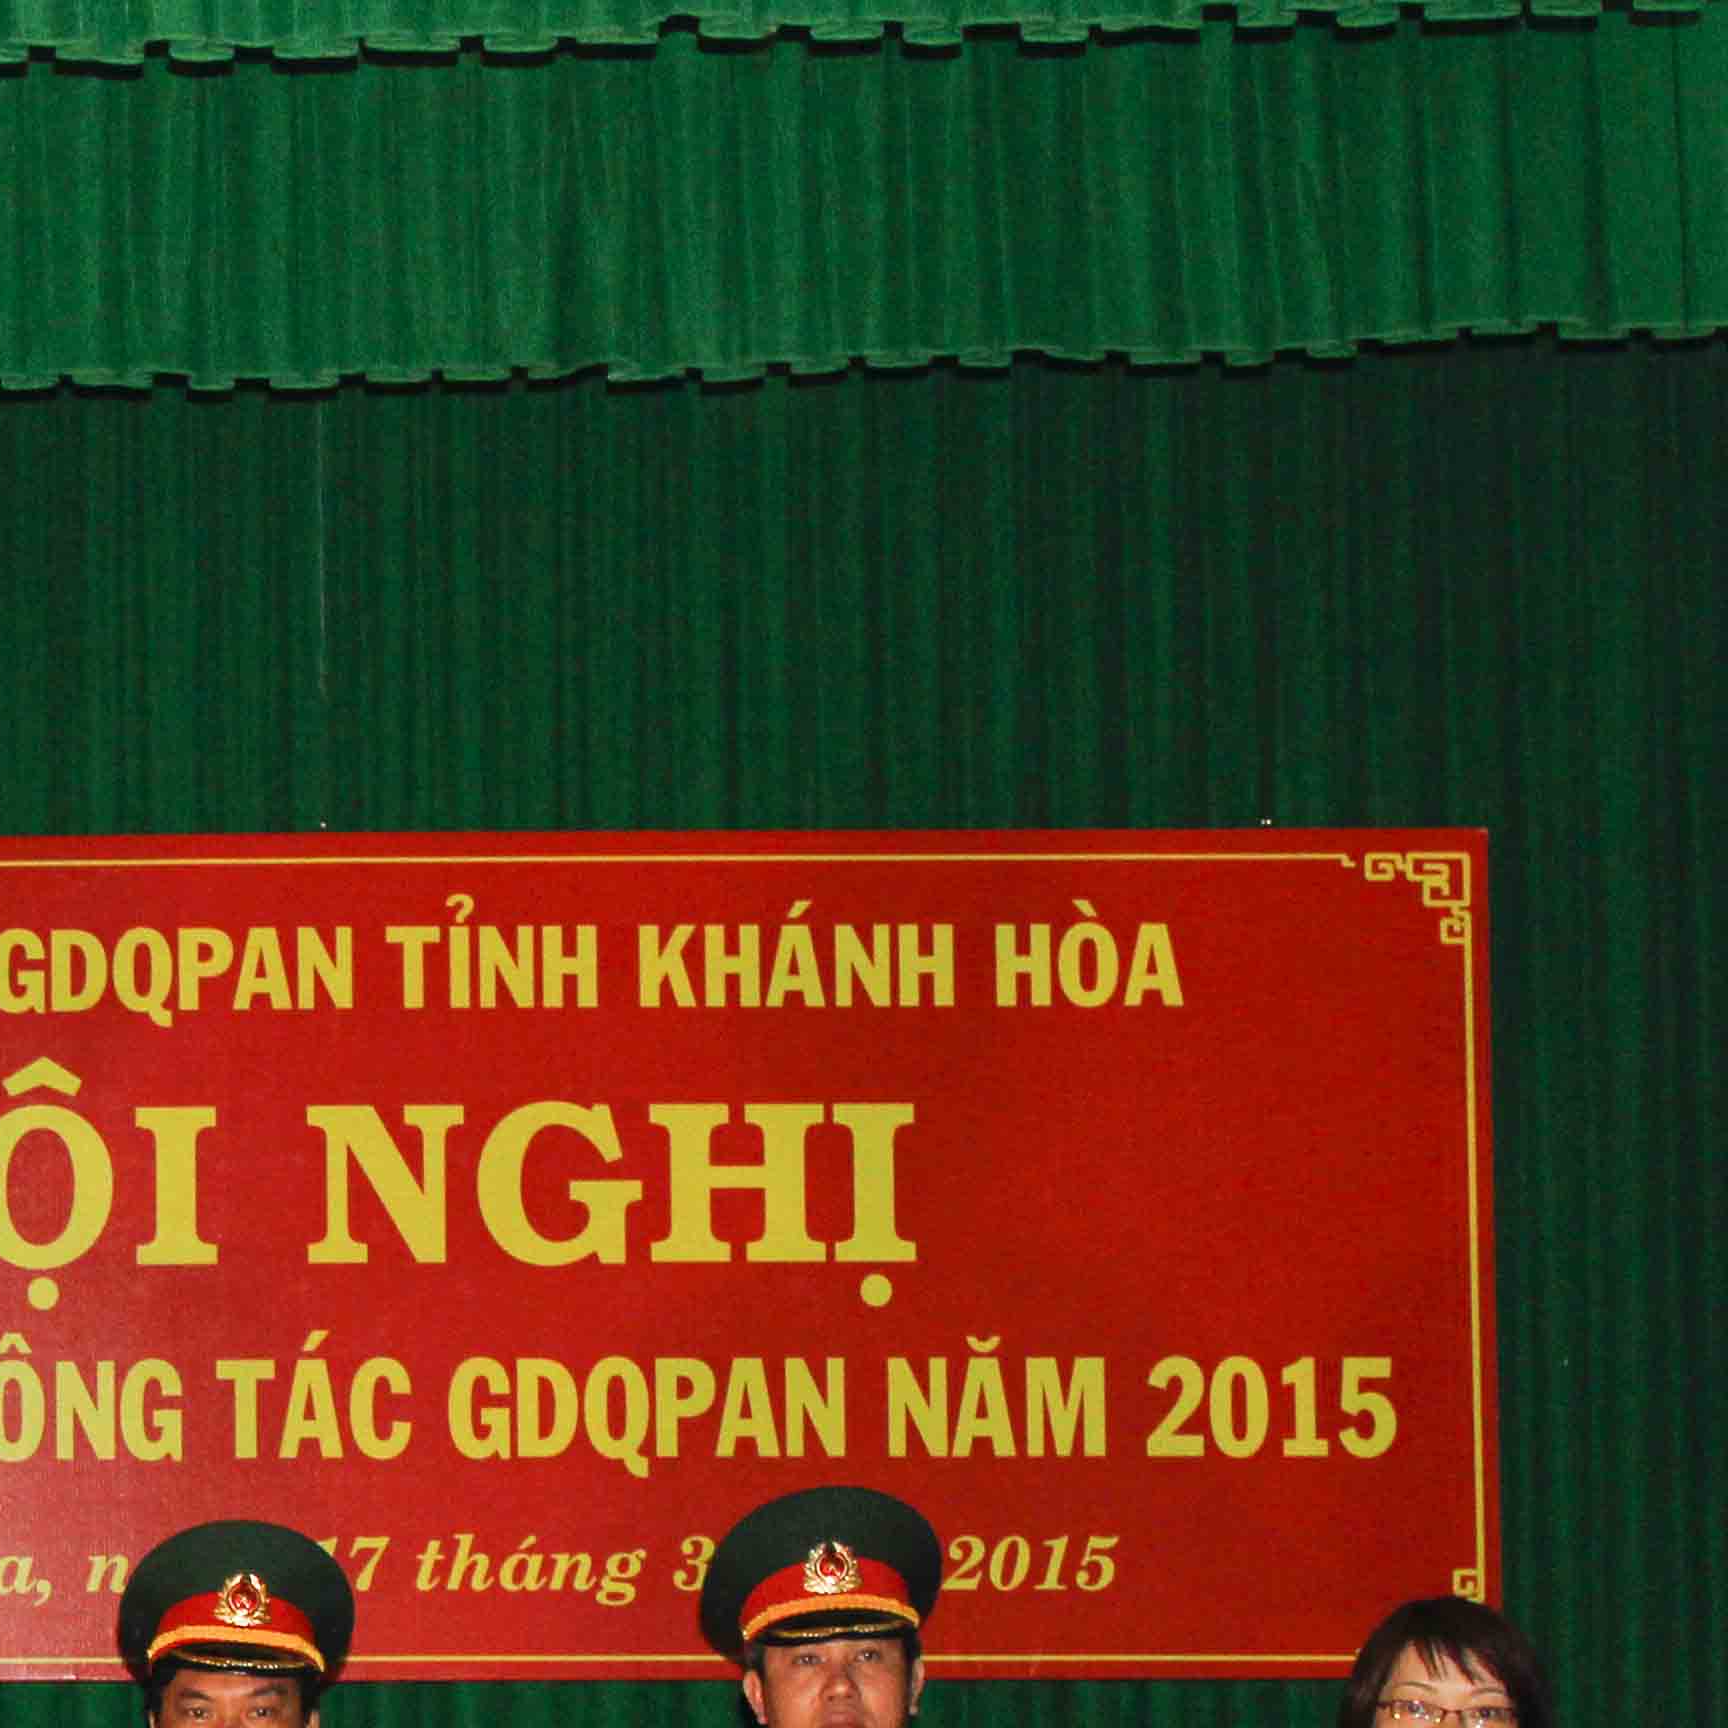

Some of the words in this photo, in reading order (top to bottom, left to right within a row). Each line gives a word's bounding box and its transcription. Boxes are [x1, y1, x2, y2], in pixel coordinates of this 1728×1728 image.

[386, 894, 598, 1009] TỈNH
[640, 900, 955, 1008] KHÁNH
[996, 899, 1184, 1008] HÒA
[307, 1101, 917, 1308] NGHỊ
[216, 1330, 412, 1460] TÁC
[448, 1356, 846, 1478] GDQPAN
[887, 1336, 1106, 1457] NĂM
[1146, 1356, 1397, 1458] 2015
[416, 1533, 647, 1607] tháng
[673, 1536, 715, 1591] 3
[942, 1535, 1119, 1592] 2015
